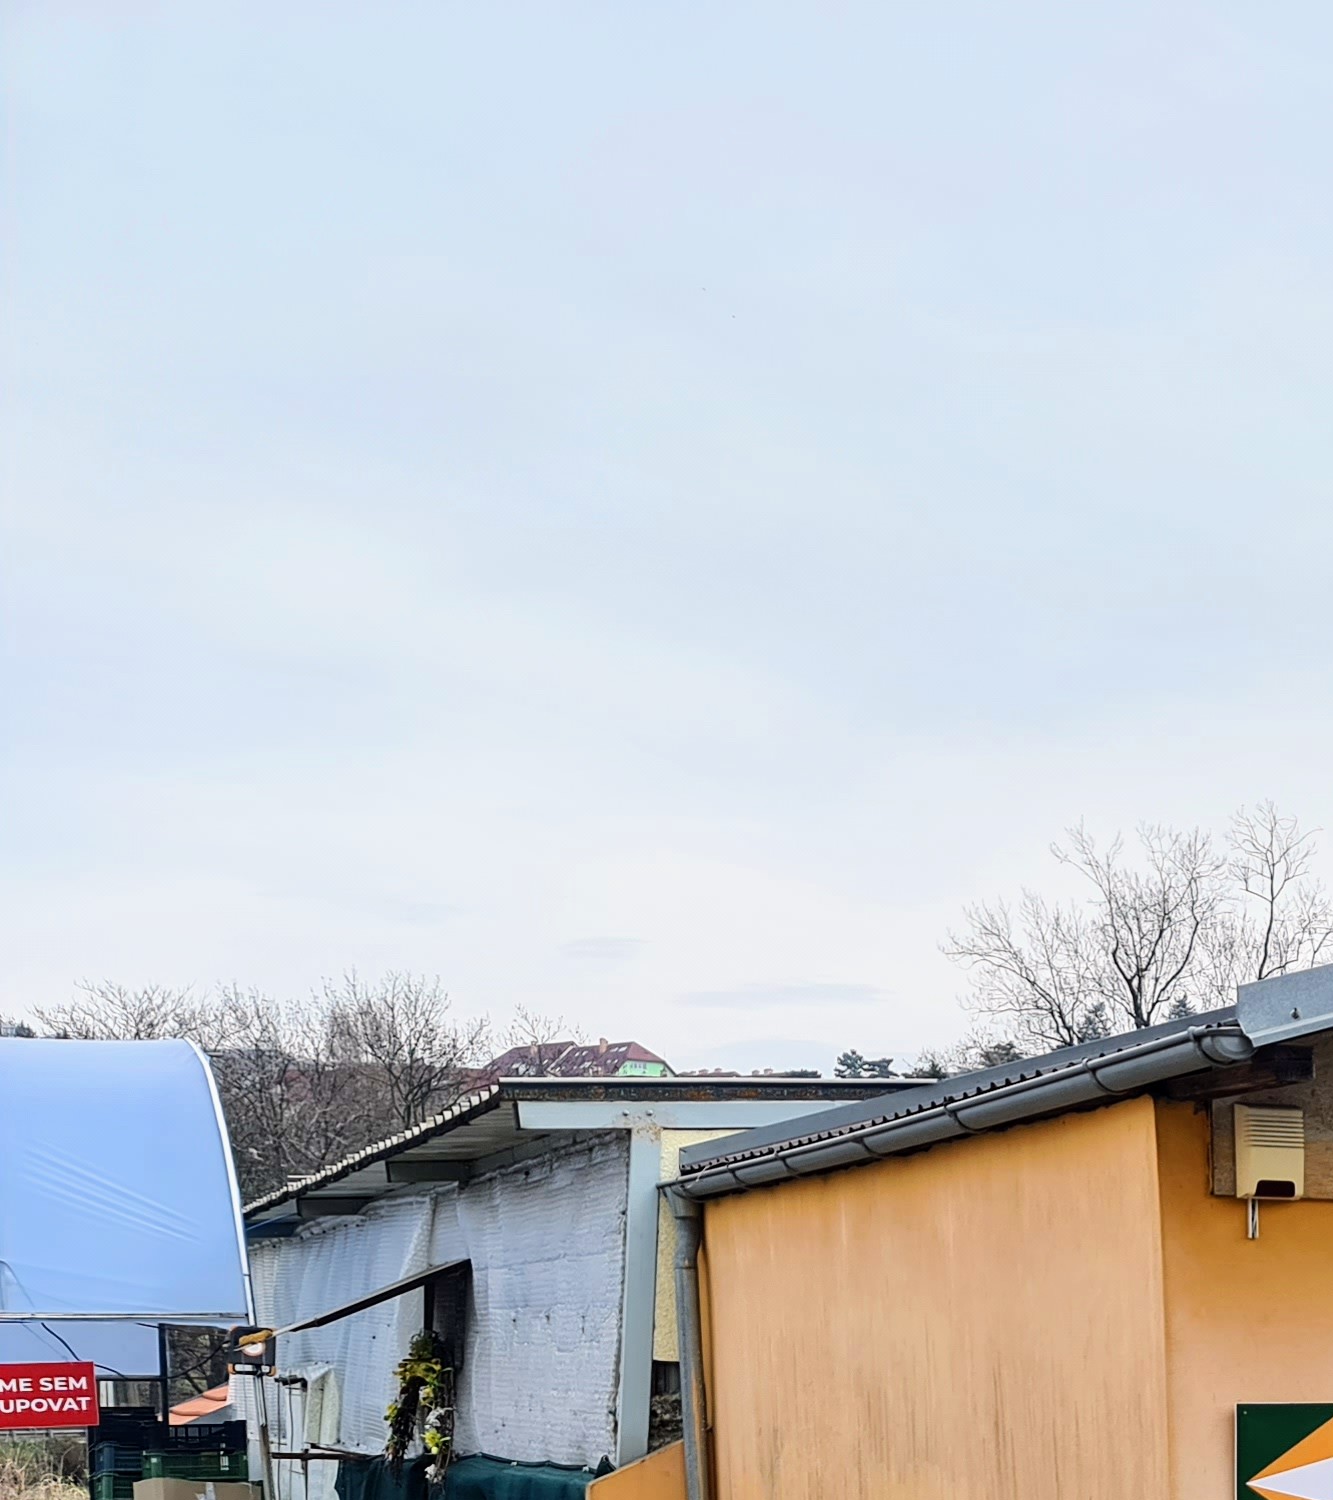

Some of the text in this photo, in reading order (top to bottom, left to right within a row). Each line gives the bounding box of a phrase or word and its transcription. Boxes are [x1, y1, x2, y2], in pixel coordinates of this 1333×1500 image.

[0, 1376, 88, 1393] ME SEM
[0, 1396, 91, 1413] UPOVAT
